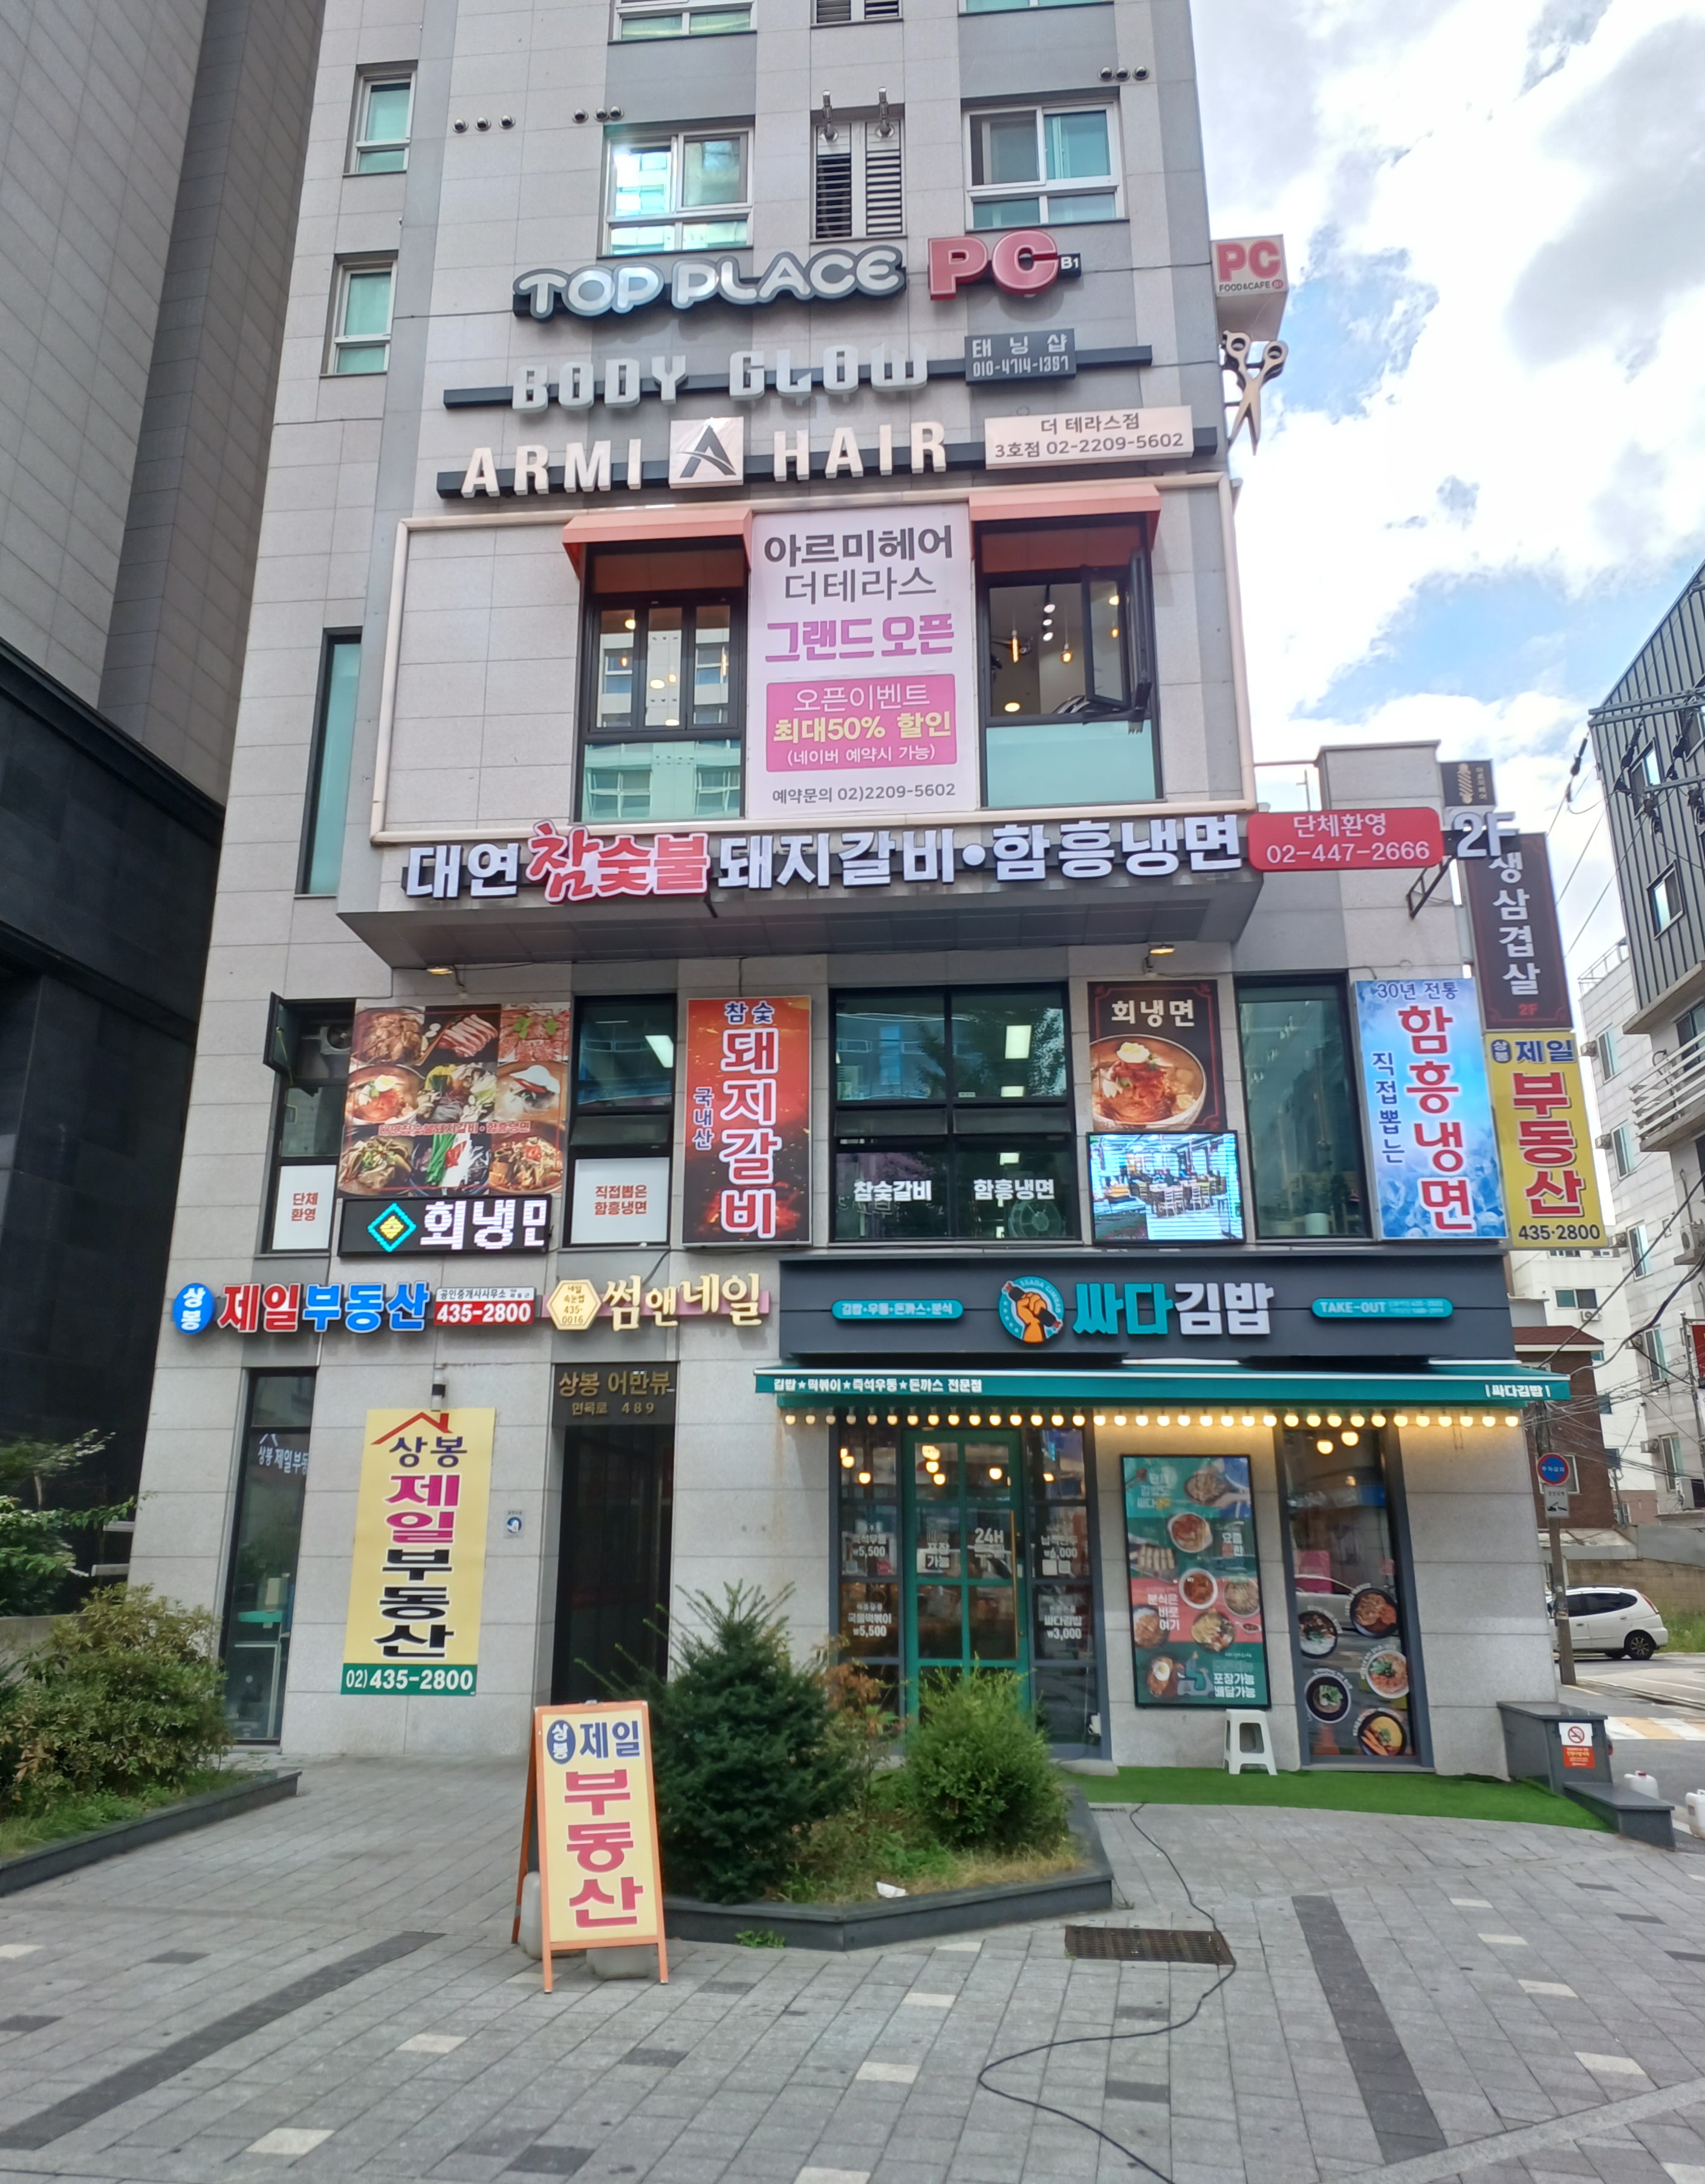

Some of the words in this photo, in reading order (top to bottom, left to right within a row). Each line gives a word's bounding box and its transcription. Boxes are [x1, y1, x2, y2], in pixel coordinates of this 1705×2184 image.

[1216, 239, 1281, 282] PC
[514, 264, 664, 319] TOP
[671, 245, 906, 310] PLACE
[928, 229, 1059, 300] PC
[1061, 256, 1079, 270] B1
[1219, 281, 1270, 293] FOOD&CAFE
[512, 355, 686, 414] BODY
[729, 342, 927, 400] GLOW
[1041, 418, 1057, 435] 더
[1065, 413, 1140, 433] 테라스점
[995, 441, 1041, 458] 3호점
[1047, 433, 1184, 455] 02-2209-5602
[461, 438, 642, 498] ARMI
[773, 422, 946, 481] HAIR
[764, 525, 952, 568] 아르미헤어
[785, 567, 937, 605] 더테라스
[765, 618, 874, 663] 그랜드
[881, 613, 954, 658] 오픈
[793, 683, 930, 712] 오픈이벤트
[773, 715, 886, 744] 최대50%
[896, 711, 952, 739] 할인
[788, 747, 839, 767] (네이버
[845, 746, 892, 764] 예약시
[898, 743, 936, 762] 가능)
[772, 787, 832, 804] 예약문의
[837, 784, 956, 802] 02)2209-5602
[1294, 813, 1386, 839] 단체환영
[1453, 811, 1516, 859] 2F
[406, 843, 520, 899] 대연
[525, 820, 710, 905] 참숯불
[993, 814, 1242, 882] 함흥냉면
[1266, 841, 1430, 864] 02-447-2666
[1488, 852, 1541, 996] 생삼겹살
[1377, 983, 1417, 1000] 30년
[1424, 981, 1458, 1000] 전통
[724, 1001, 775, 1024] 참숯
[1111, 999, 1195, 1028] 회냉면
[1519, 1003, 1539, 1016] 2F
[1515, 1039, 1577, 1064] 제일
[693, 1088, 714, 1149] 국내산
[1398, 1006, 1473, 1230] 함흥냉면
[719, 1027, 782, 1240] 돼지갈비
[1513, 1071, 1585, 1218] 부동산
[293, 1192, 318, 1206] 단체
[854, 1180, 932, 1202] 참숯갈비
[973, 1178, 1055, 1201] 함흥냉면
[291, 1207, 316, 1222] 환영
[594, 1201, 647, 1215] 함흥냉면
[441, 1289, 506, 1299] 공인중개사사무소
[181, 1287, 206, 1330] 상봉
[437, 1303, 531, 1323] 435-2800
[562, 1315, 583, 1324] 0016
[1320, 1301, 1386, 1313] TAKE-OUT
[559, 1371, 600, 1397] 상봉
[774, 1379, 796, 1391] 김밥
[909, 1379, 944, 1392] 돈까스
[947, 1379, 982, 1393] 전문점
[622, 1402, 654, 1414] 489
[258, 1446, 273, 1466] 상봉
[389, 1436, 467, 1467] 상봉
[975, 1527, 1004, 1544] 24H
[1160, 1619, 1180, 1631] 여기
[1213, 1672, 1255, 1685] 포장가능
[1214, 1685, 1256, 1698] 배달가능
[551, 1723, 570, 1760] 상봉
[579, 1720, 640, 1758] 제일
[565, 1769, 643, 1928] 부동산
